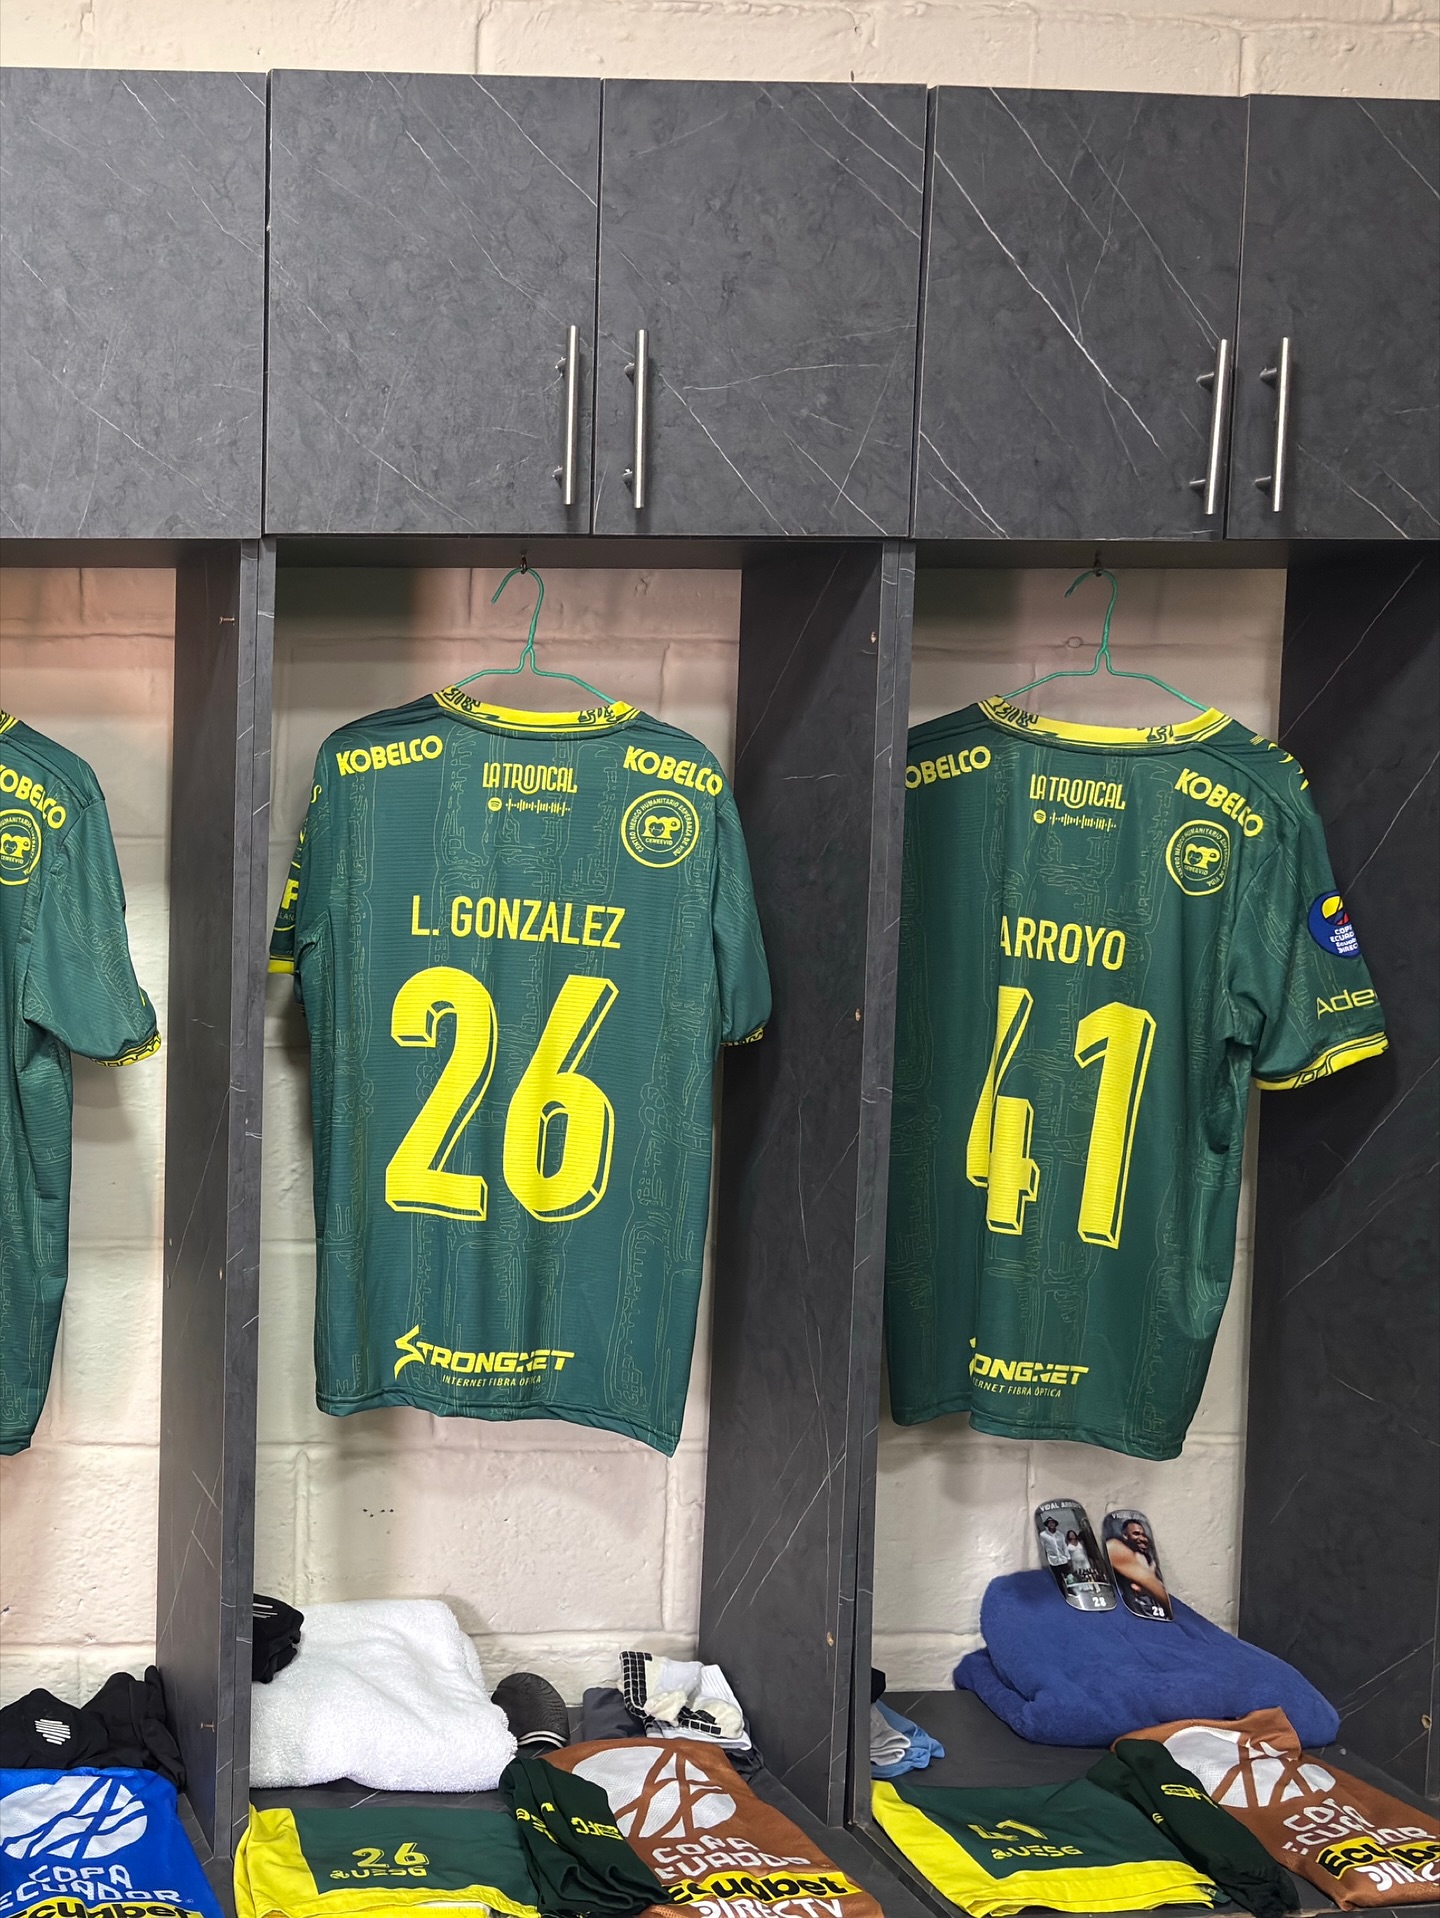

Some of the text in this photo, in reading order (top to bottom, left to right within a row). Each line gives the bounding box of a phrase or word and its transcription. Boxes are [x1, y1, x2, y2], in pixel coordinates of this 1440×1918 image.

[336, 735, 443, 776] KOBELCO
[623, 745, 723, 797] KOBELCO
[905, 746, 991, 789] OBELCO
[0, 764, 66, 829] OBELCO
[482, 762, 578, 795] LA TRONCAL
[1029, 773, 1126, 810] LA TRONCAL
[1174, 768, 1264, 837] KOBELCO
[411, 895, 626, 950] L. GONZALEZ
[1000, 915, 1126, 971] ARROYO
[1316, 989, 1376, 1019] Ade
[385, 966, 619, 1222] 26
[966, 985, 1156, 1249] 41
[394, 1324, 575, 1381] STRONGNET
[442, 1374, 487, 1388] INTERNET
[489, 1376, 516, 1388] FIBRA
[973, 1378, 1006, 1394] ERNET
[1008, 1385, 1032, 1396] FIBRA
[352, 1842, 430, 1868] 26
[652, 1834, 760, 1864] COPA
[0, 1881, 184, 1912] ECUADOR
[28, 1864, 133, 1890] COPA
